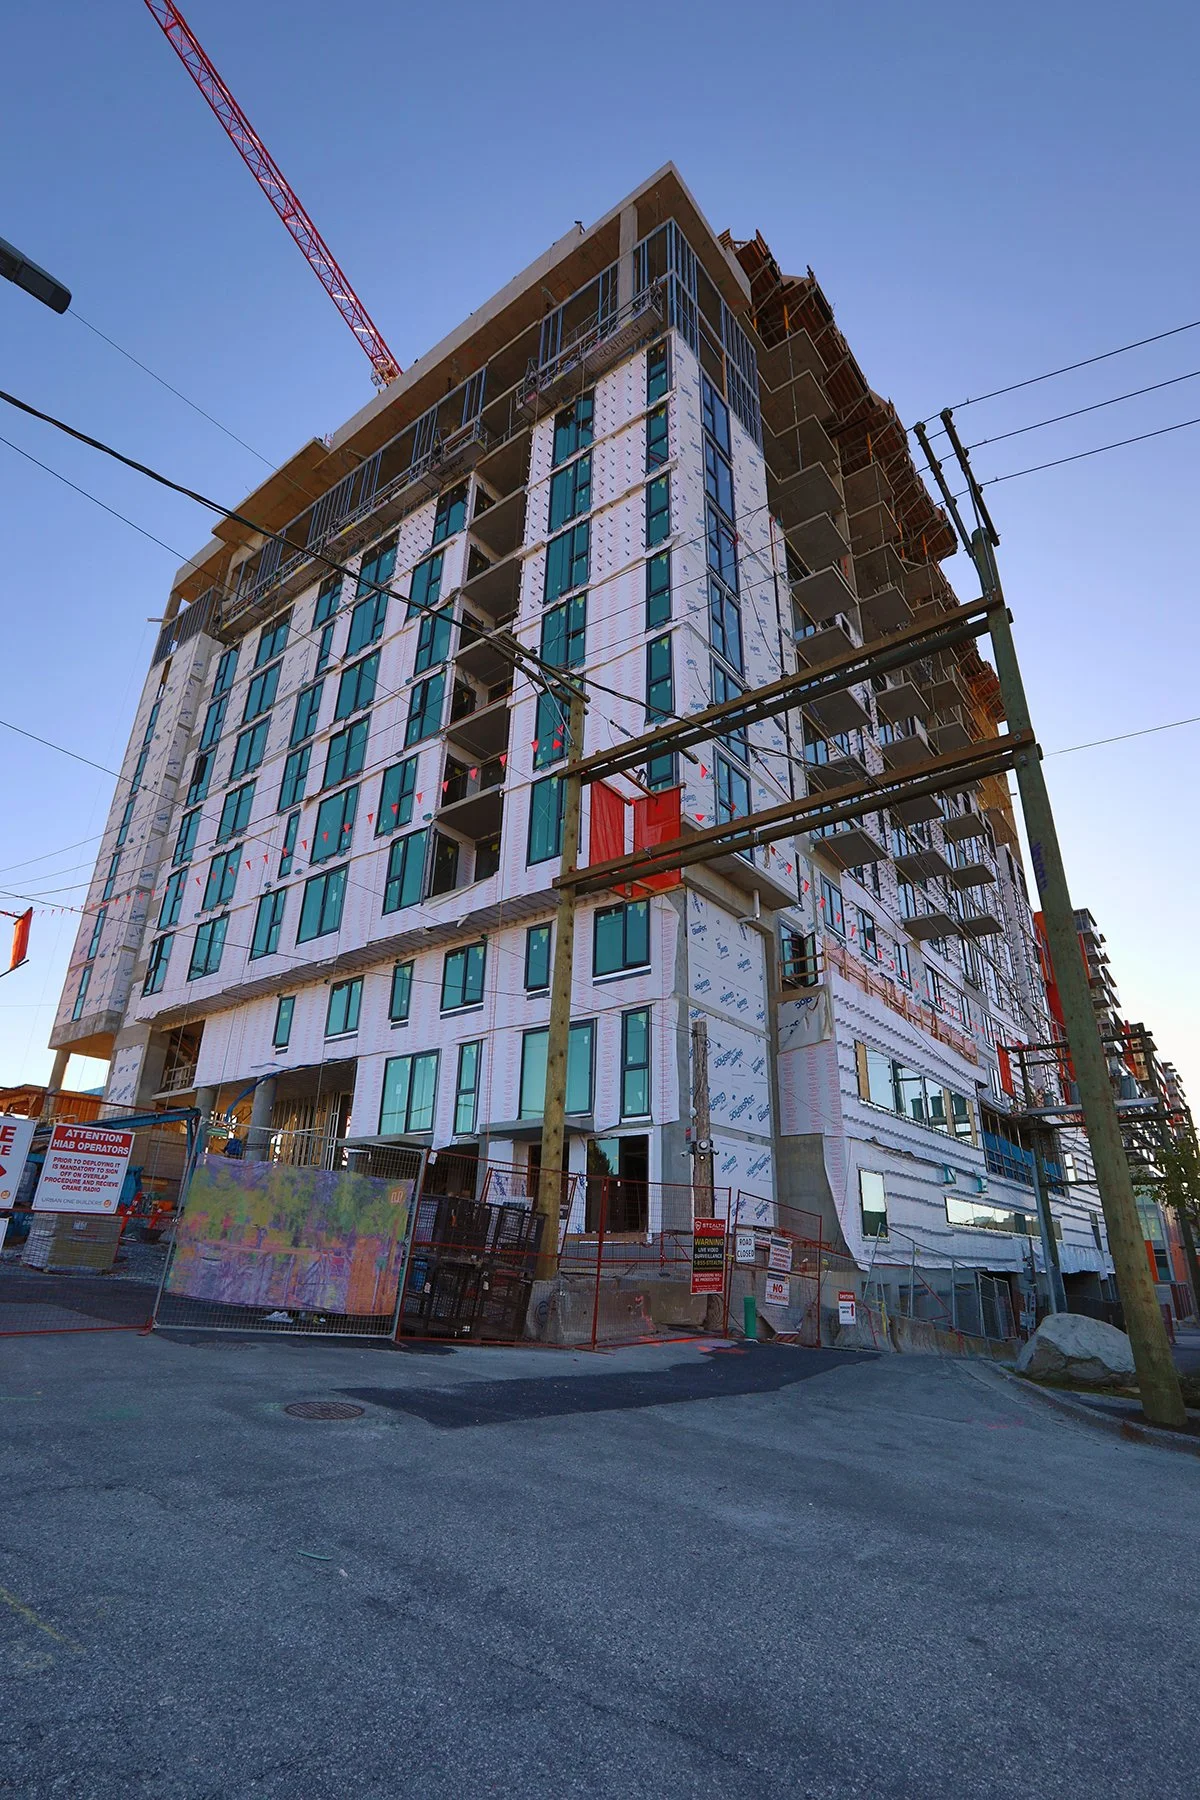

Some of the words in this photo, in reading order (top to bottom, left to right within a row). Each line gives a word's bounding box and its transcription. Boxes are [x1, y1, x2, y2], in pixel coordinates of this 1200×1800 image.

[65, 1128, 123, 1143] ATTENTION
[52, 1139, 75, 1150] HIAB
[77, 1141, 129, 1155] OPERATORS
[53, 1156, 73, 1164] PRIOR
[82, 1159, 114, 1168] DEPLOYING
[60, 1164, 95, 1173] MANDATORY
[83, 1172, 109, 1180] OVERLAP
[44, 1176, 81, 1185] PROCEDURE
[95, 1180, 120, 1188] RECIEVE
[61, 1184, 81, 1192] CRANE
[694, 1238, 724, 1246] WARNING
[739, 1238, 753, 1246] ROAD
[736, 1249, 755, 1258] CLOSED
[772, 1283, 783, 1294] NO
